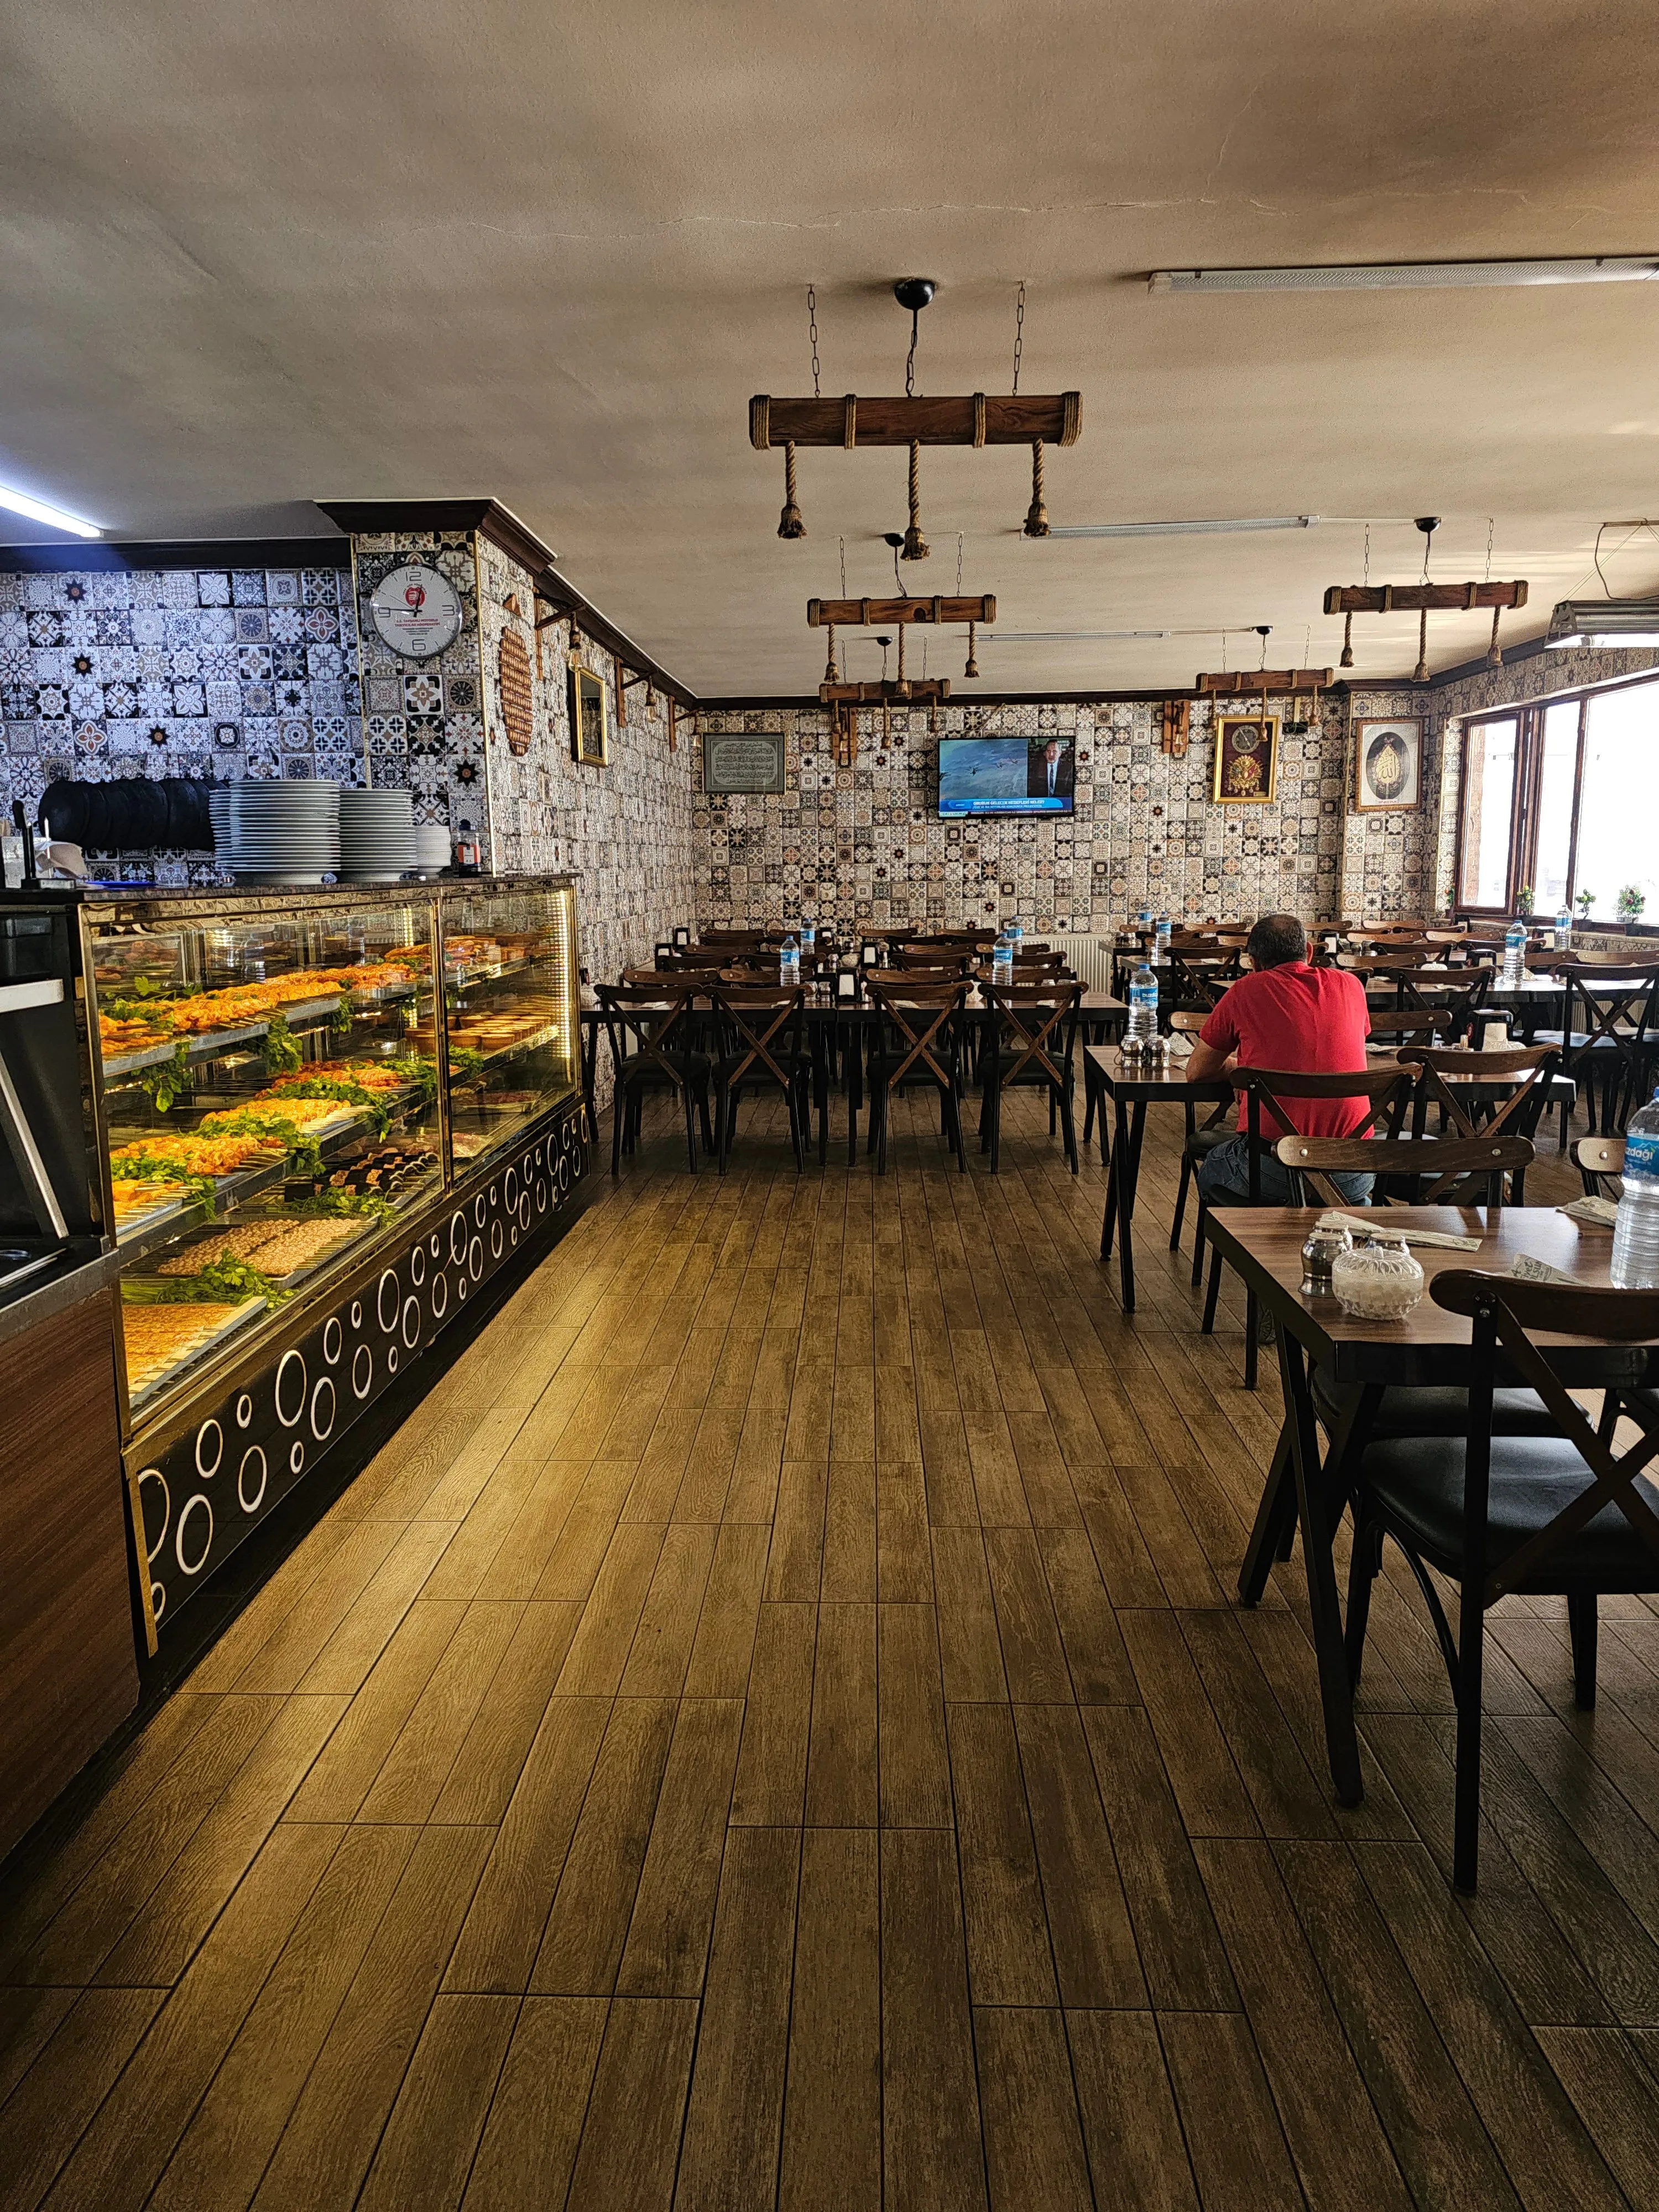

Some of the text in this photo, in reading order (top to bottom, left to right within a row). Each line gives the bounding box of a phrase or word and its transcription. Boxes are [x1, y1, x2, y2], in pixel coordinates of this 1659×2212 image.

[405, 571, 422, 581] 12
[378, 607, 391, 618] 9
[442, 604, 455, 616] 3
[412, 639, 426, 651] 6
[1625, 1147, 1653, 1161] zdağı
